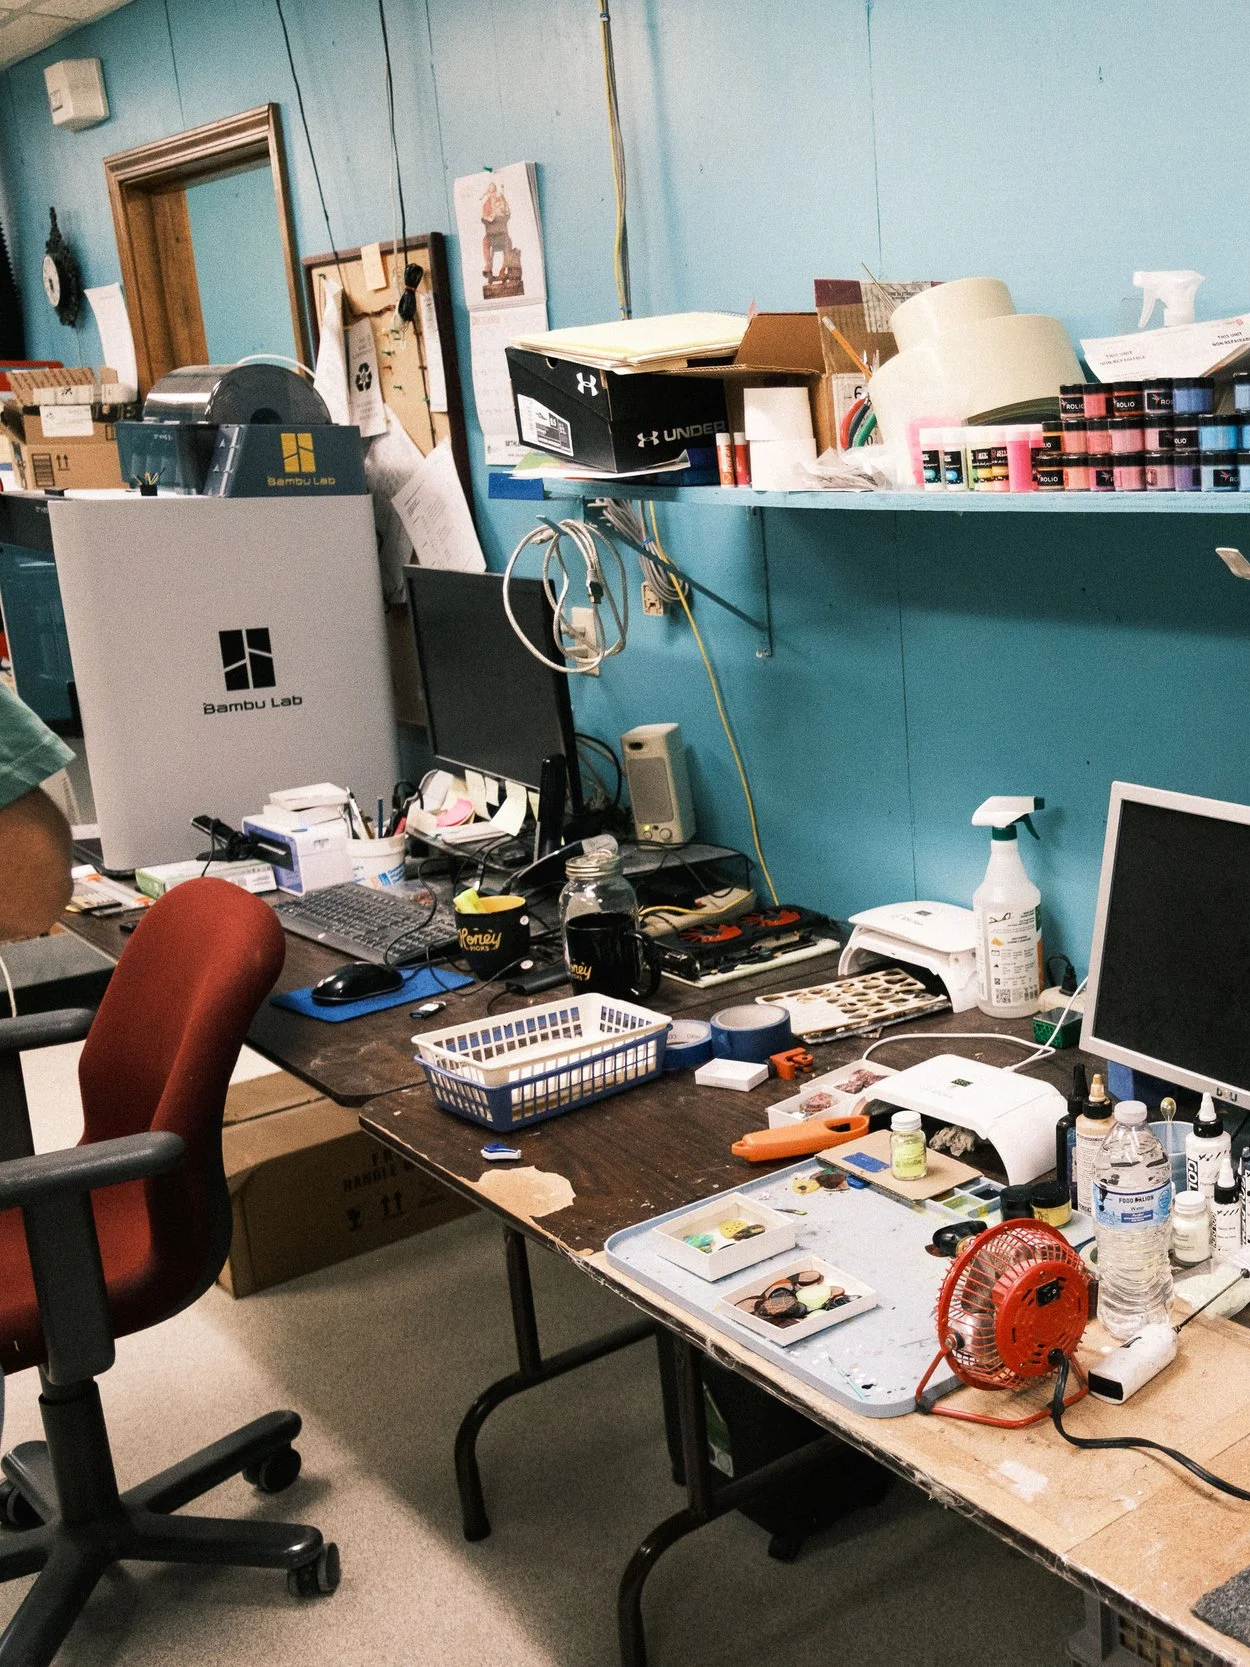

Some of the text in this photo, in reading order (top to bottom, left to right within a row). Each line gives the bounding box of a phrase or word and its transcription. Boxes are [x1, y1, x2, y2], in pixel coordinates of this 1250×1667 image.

[664, 420, 727, 442] UNDER
[267, 476, 336, 487] Bambu Lab
[203, 695, 303, 715] Bambu Lab
[570, 963, 592, 981] oney
[1187, 1158, 1199, 1191] GOL
